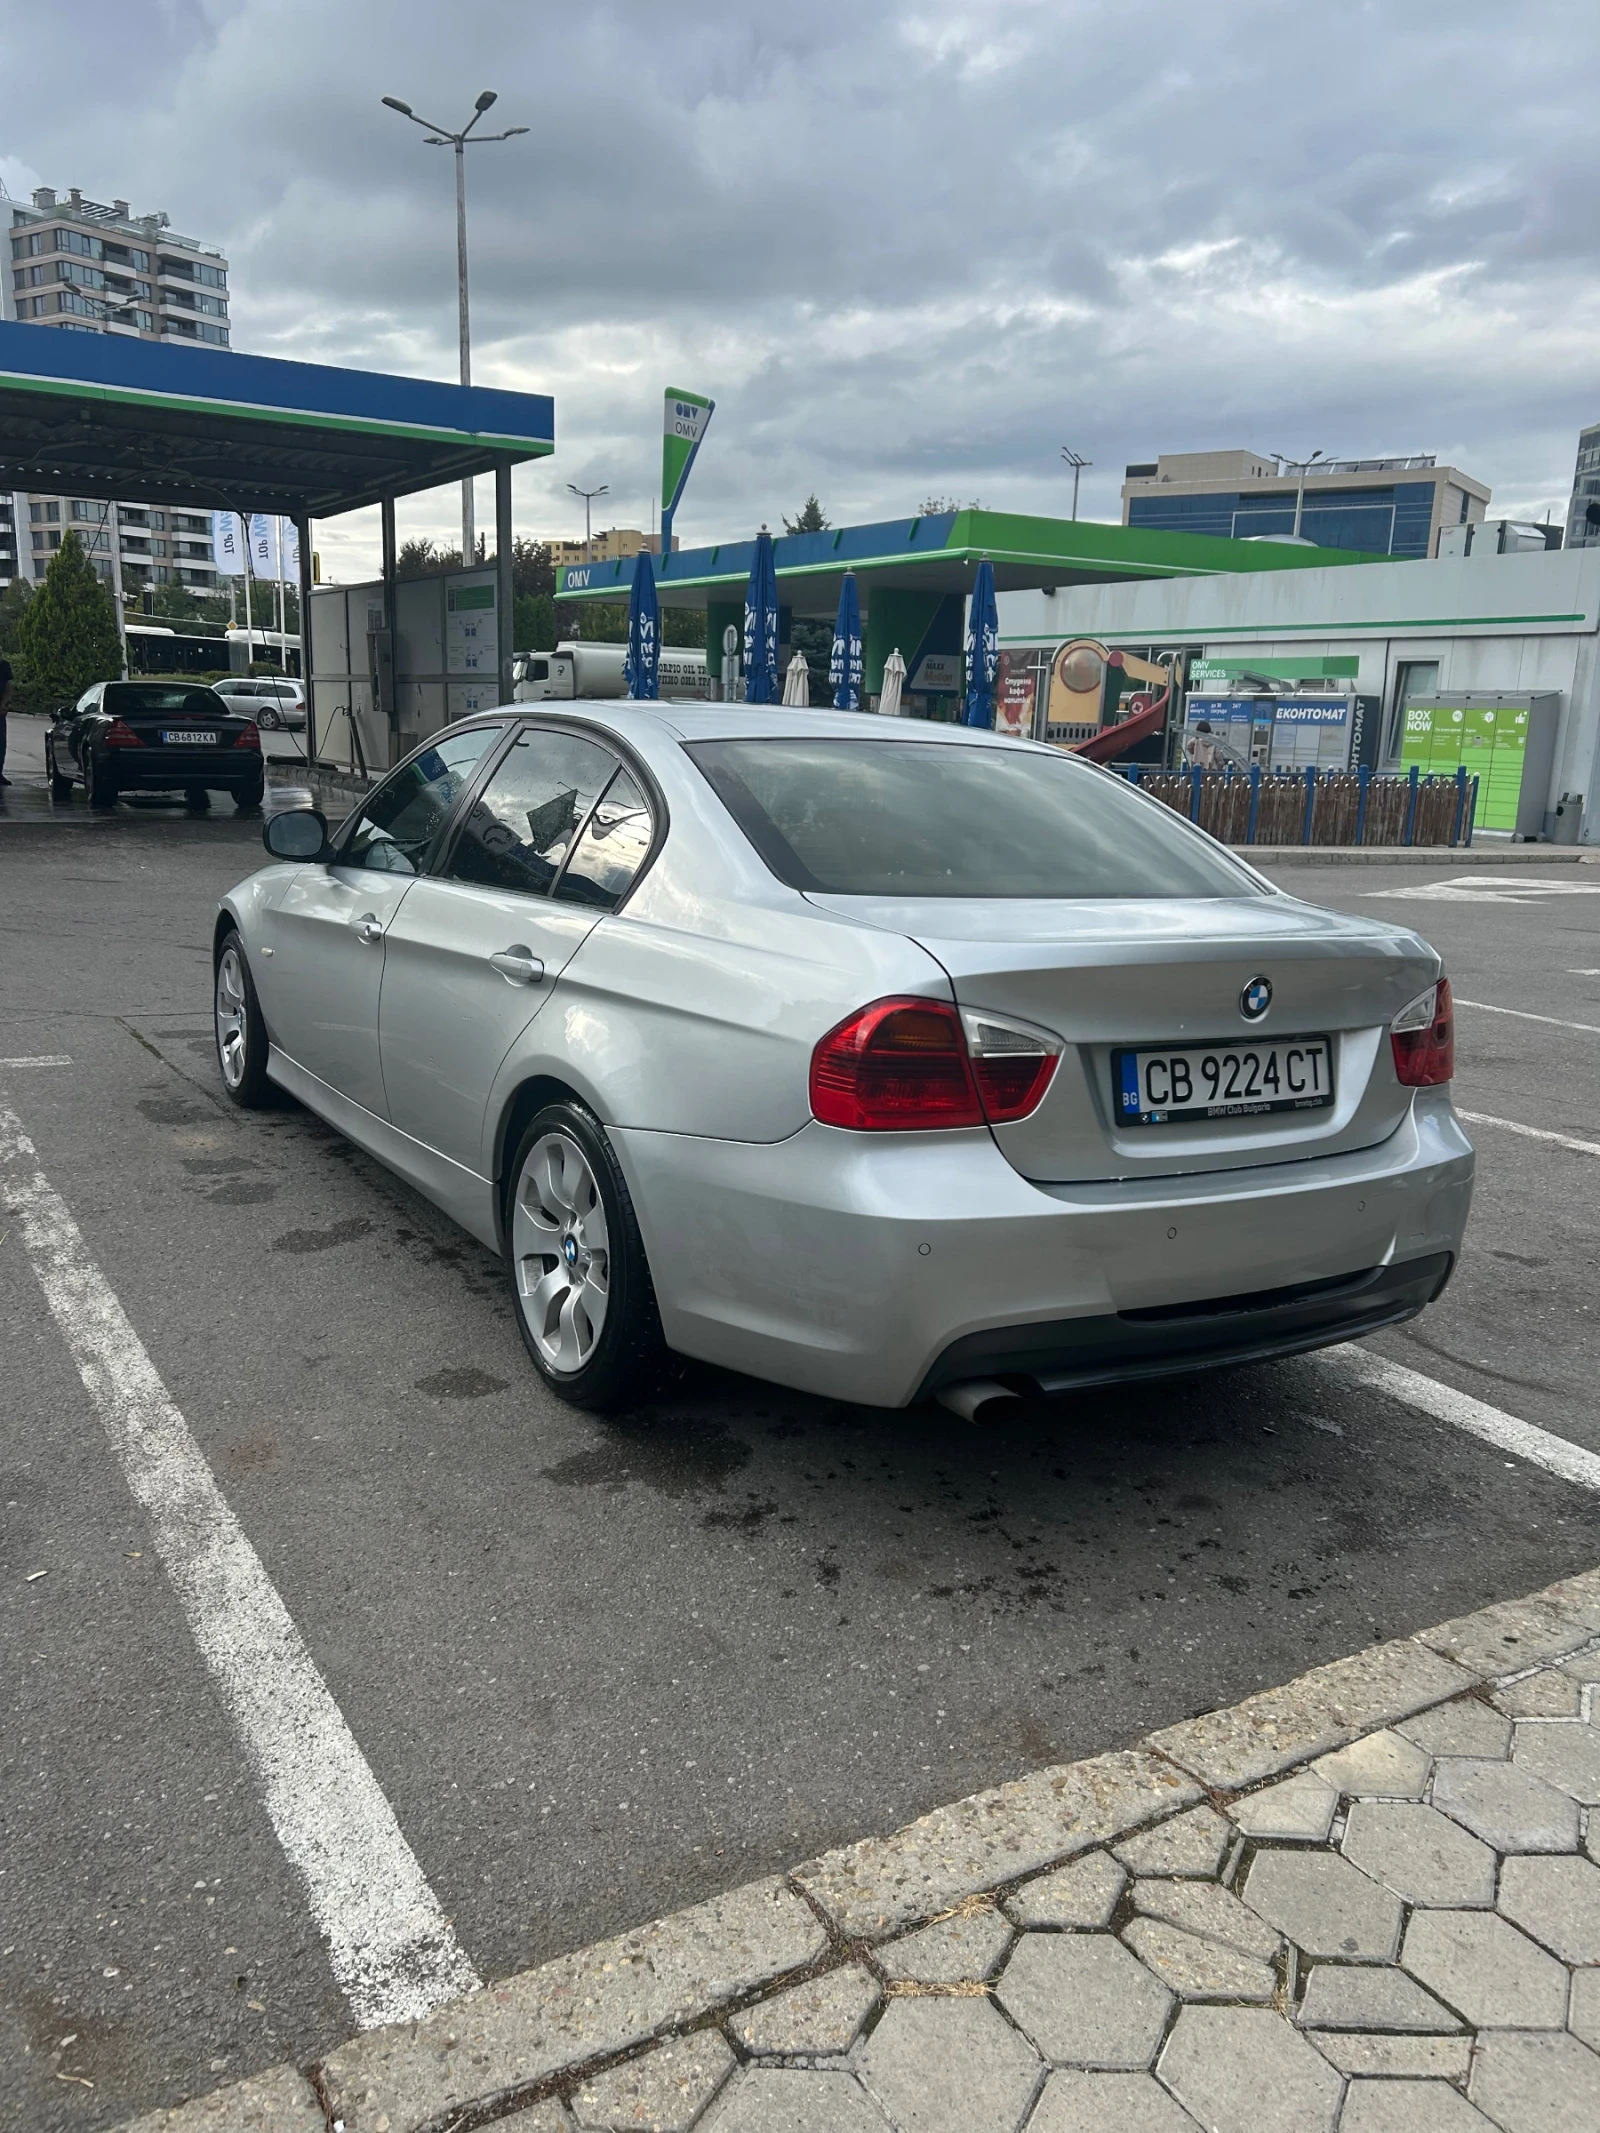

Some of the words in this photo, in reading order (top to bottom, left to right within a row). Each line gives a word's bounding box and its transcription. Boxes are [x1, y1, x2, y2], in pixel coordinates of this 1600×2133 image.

[675, 421, 698, 438] OMV
[567, 569, 591, 588] OMV
[658, 662, 681, 674] ORPIO
[682, 664, 696, 675] OIL
[925, 662, 946, 671] MAXX
[1192, 660, 1210, 670] OMV
[1190, 669, 1227, 679] SERVICES
[1276, 707, 1346, 720] ЕКОНТОМАТ
[1408, 710, 1431, 720] BOX
[1406, 721, 1432, 732] NOW
[1350, 698, 1365, 776] ОНТОМАТ
[1145, 1057, 1193, 1105] CB
[1201, 1051, 1280, 1100] 9224
[1286, 1048, 1323, 1092] CT
[1123, 1092, 1138, 1106] BG
[1207, 1106, 1227, 1117] BMW
[1227, 1104, 1244, 1114] Club
[1243, 1102, 1271, 1115] Bulgaria
